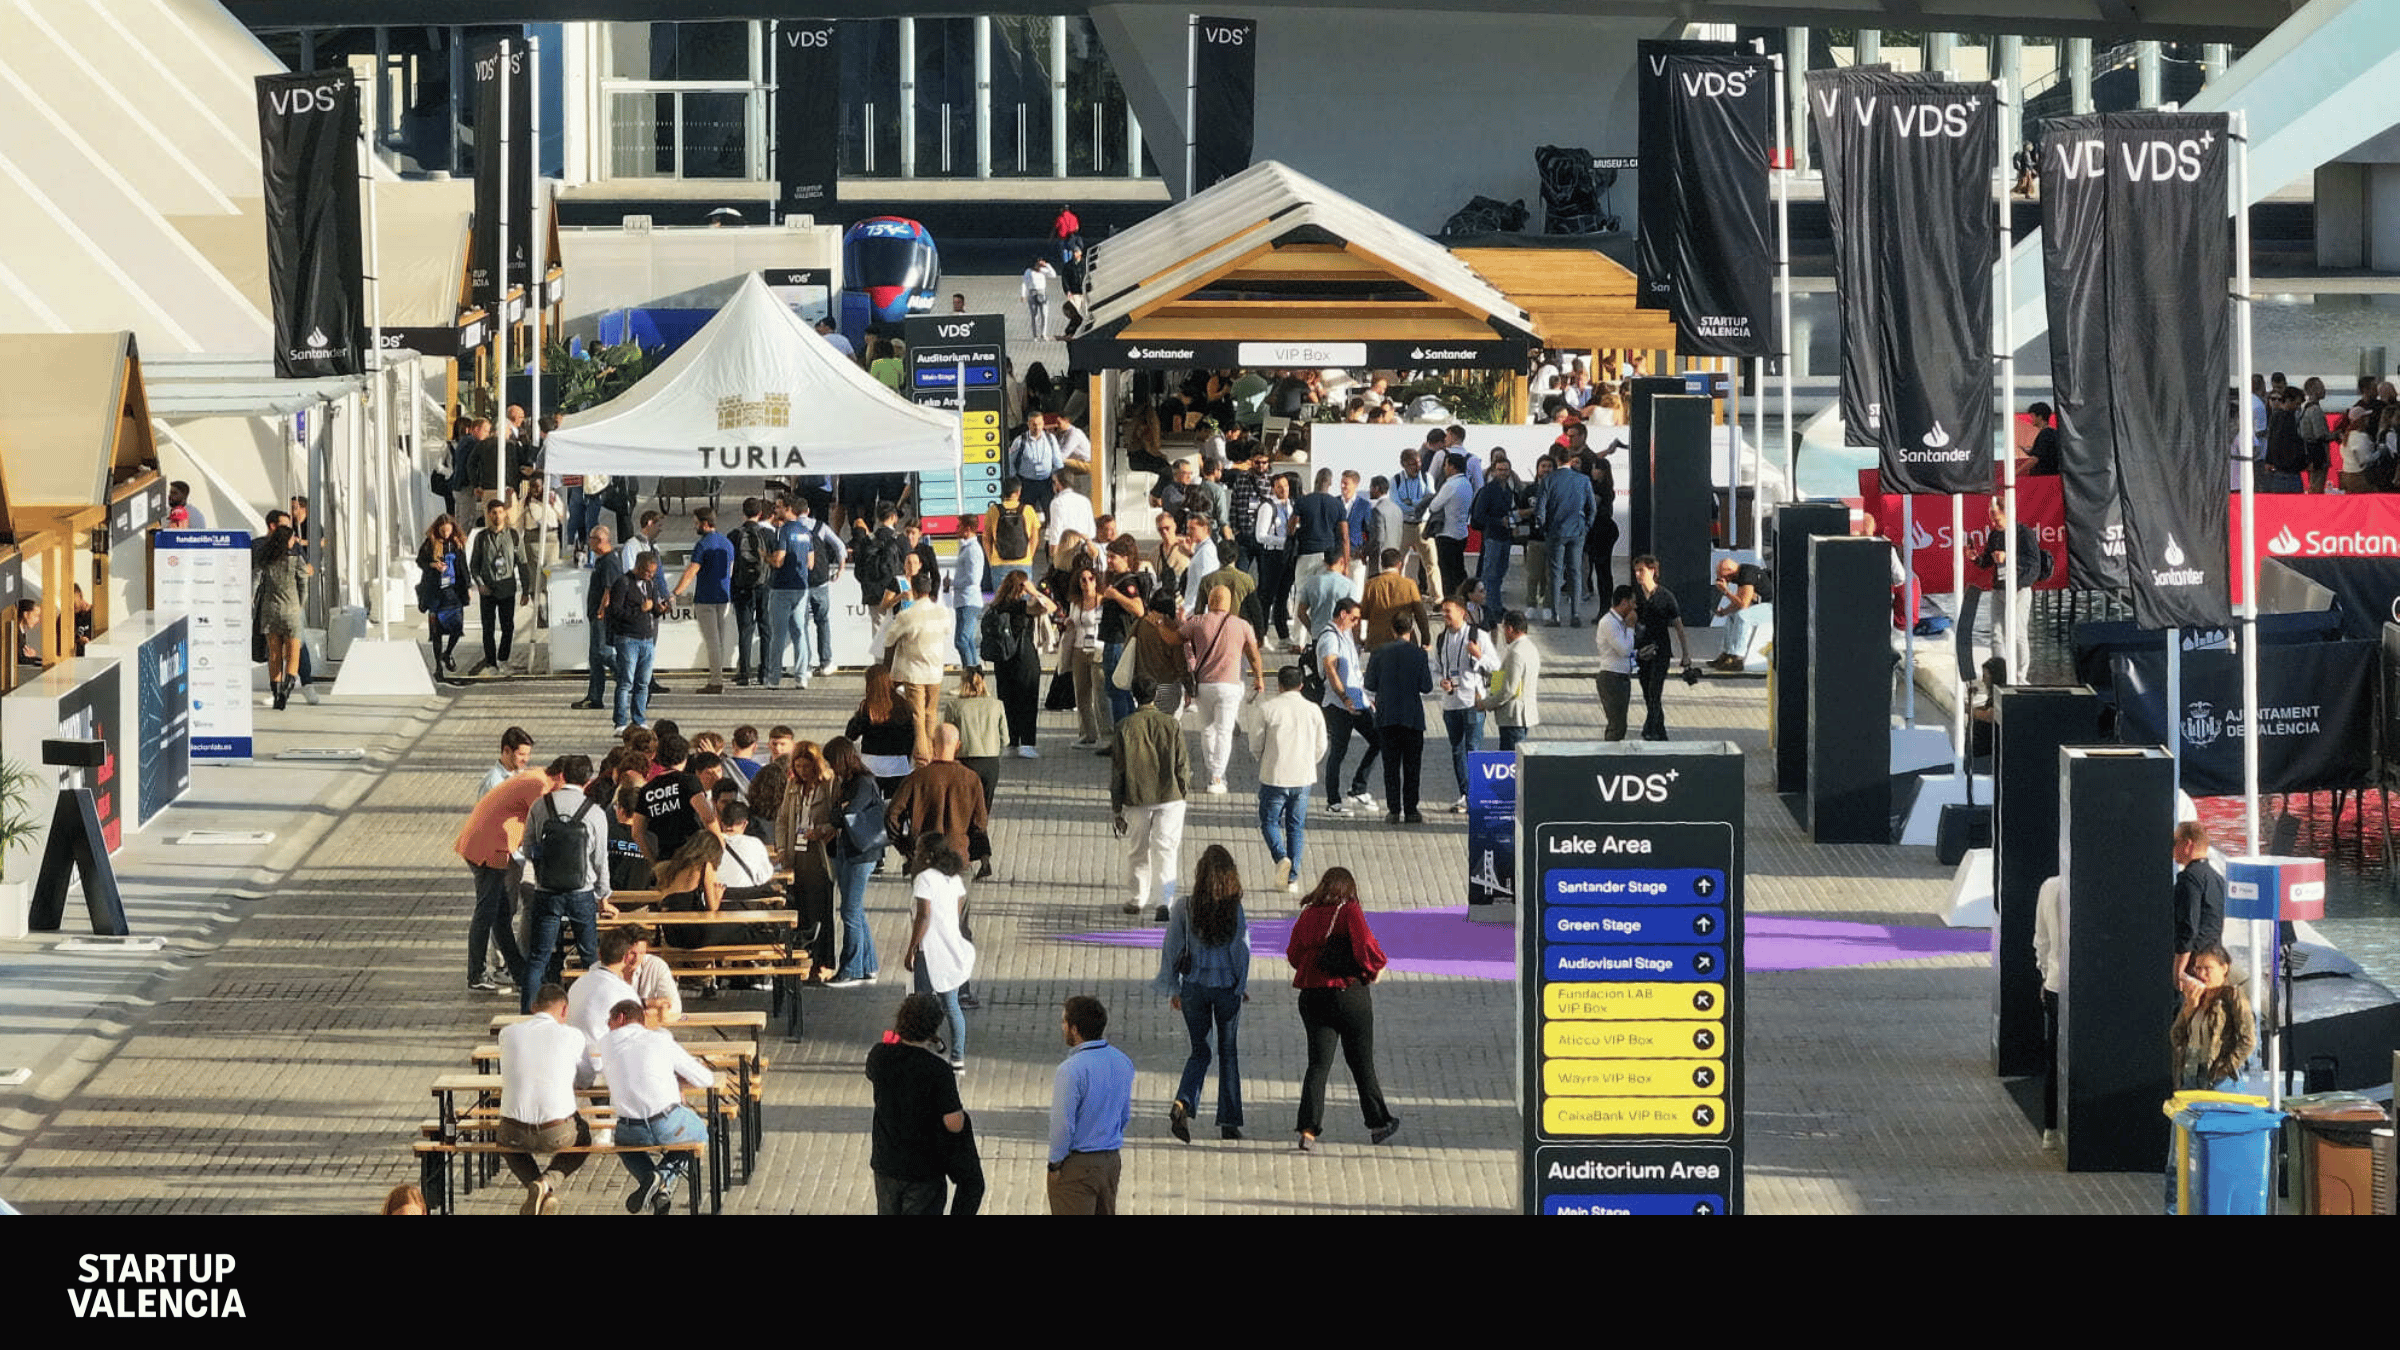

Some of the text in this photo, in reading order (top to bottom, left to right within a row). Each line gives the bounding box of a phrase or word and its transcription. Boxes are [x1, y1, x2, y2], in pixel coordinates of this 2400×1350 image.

[1593, 158, 1622, 168] MUSEU
[1701, 316, 1748, 326] STARTUP
[1697, 326, 1751, 337] VALENCIA
[917, 352, 995, 363] Auditorium Area
[1142, 348, 1195, 359] Santander
[1274, 347, 1331, 361] VIP Box
[1425, 349, 1478, 360] Santander
[697, 445, 806, 470] TURIA
[1899, 448, 1971, 462] Santander
[645, 783, 680, 802] CORE
[647, 798, 681, 818] TEAM
[1549, 835, 1652, 854] Lake Area
[1558, 881, 1667, 896] Santander Stage
[1557, 919, 1642, 934] Green Stage
[1558, 957, 1673, 972] Audiovisual Stage
[1558, 1003, 1608, 1013] VIP Box
[1604, 1034, 1626, 1045] VIP
[1629, 1034, 1654, 1046] Box
[1558, 1072, 1652, 1086] Wayra VIP Box
[1558, 1110, 1678, 1121] CaixaBank VIP Box
[1548, 1161, 1720, 1180] Auditorium Area
